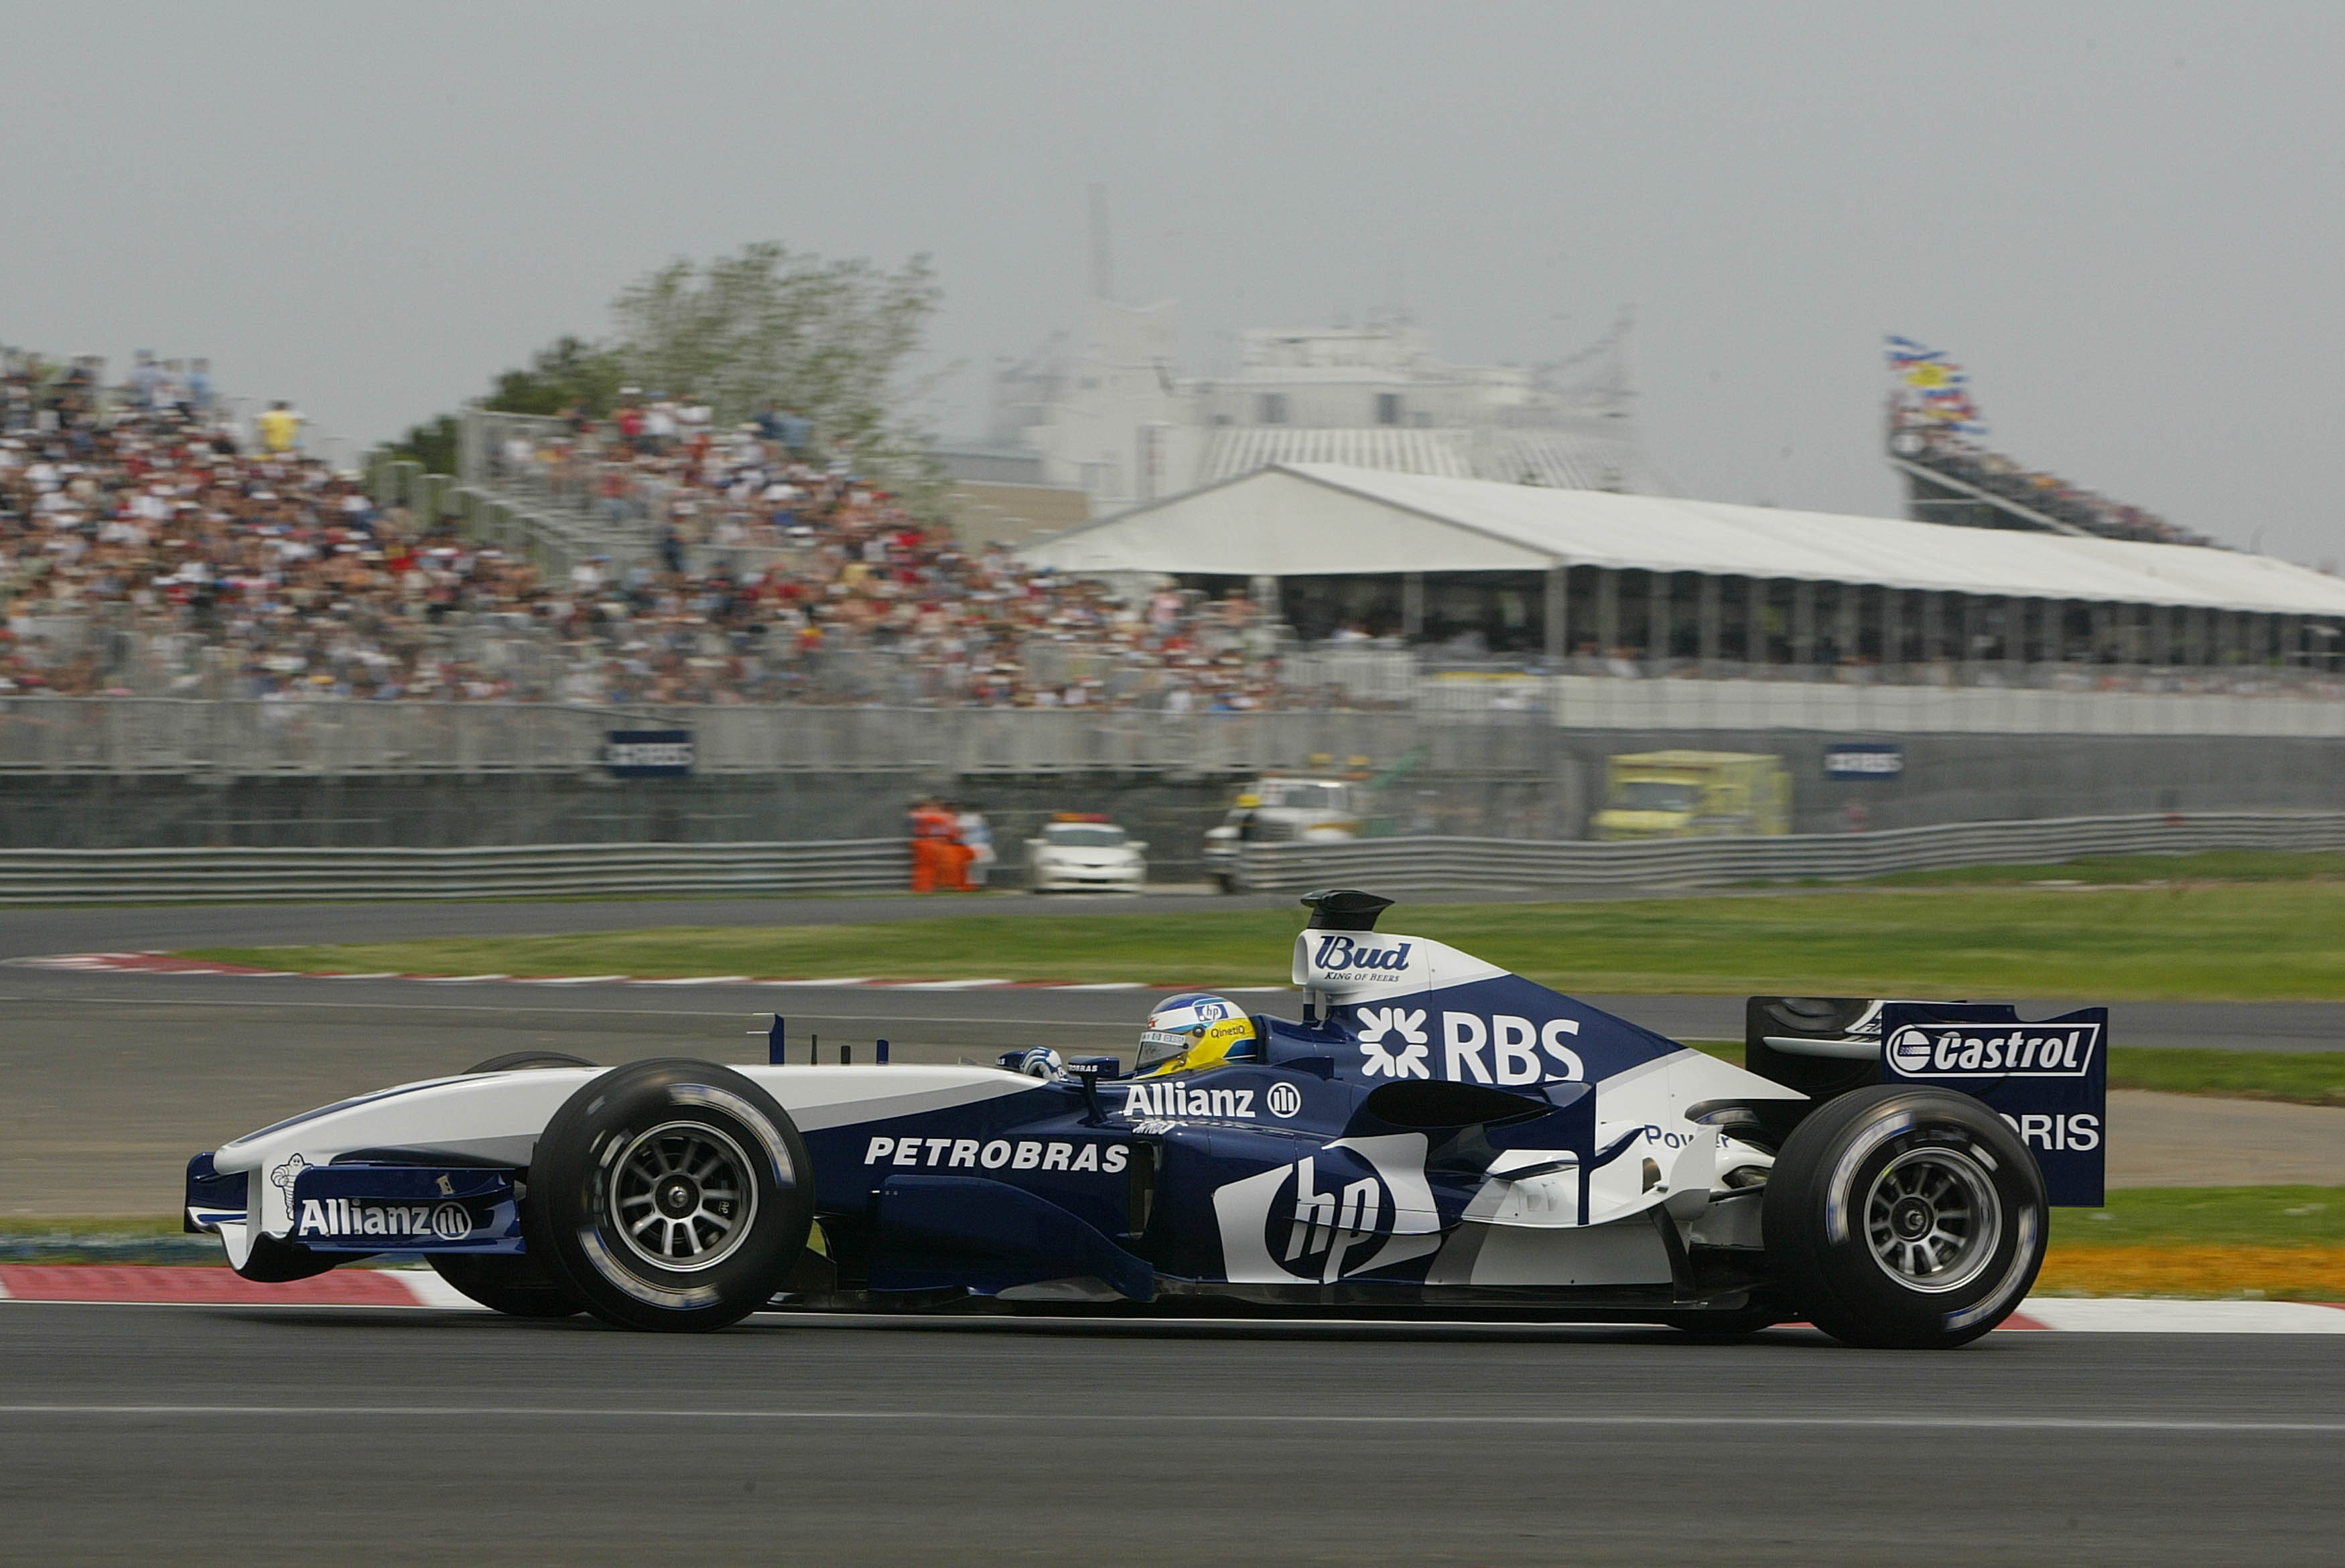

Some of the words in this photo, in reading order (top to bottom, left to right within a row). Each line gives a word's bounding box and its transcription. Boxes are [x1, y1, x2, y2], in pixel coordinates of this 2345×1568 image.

[1315, 936, 1412, 971] Bud
[1206, 1005, 1219, 1019] hp
[1443, 1011, 1584, 1086] RBS
[1934, 1031, 2080, 1070] Castrol
[1123, 1081, 1256, 1118] Allianz
[1999, 1113, 2100, 1151] RIS
[864, 1137, 1130, 1173] PETROBRAS
[298, 1198, 432, 1236] Allianz
[1284, 1156, 1381, 1285] hp
